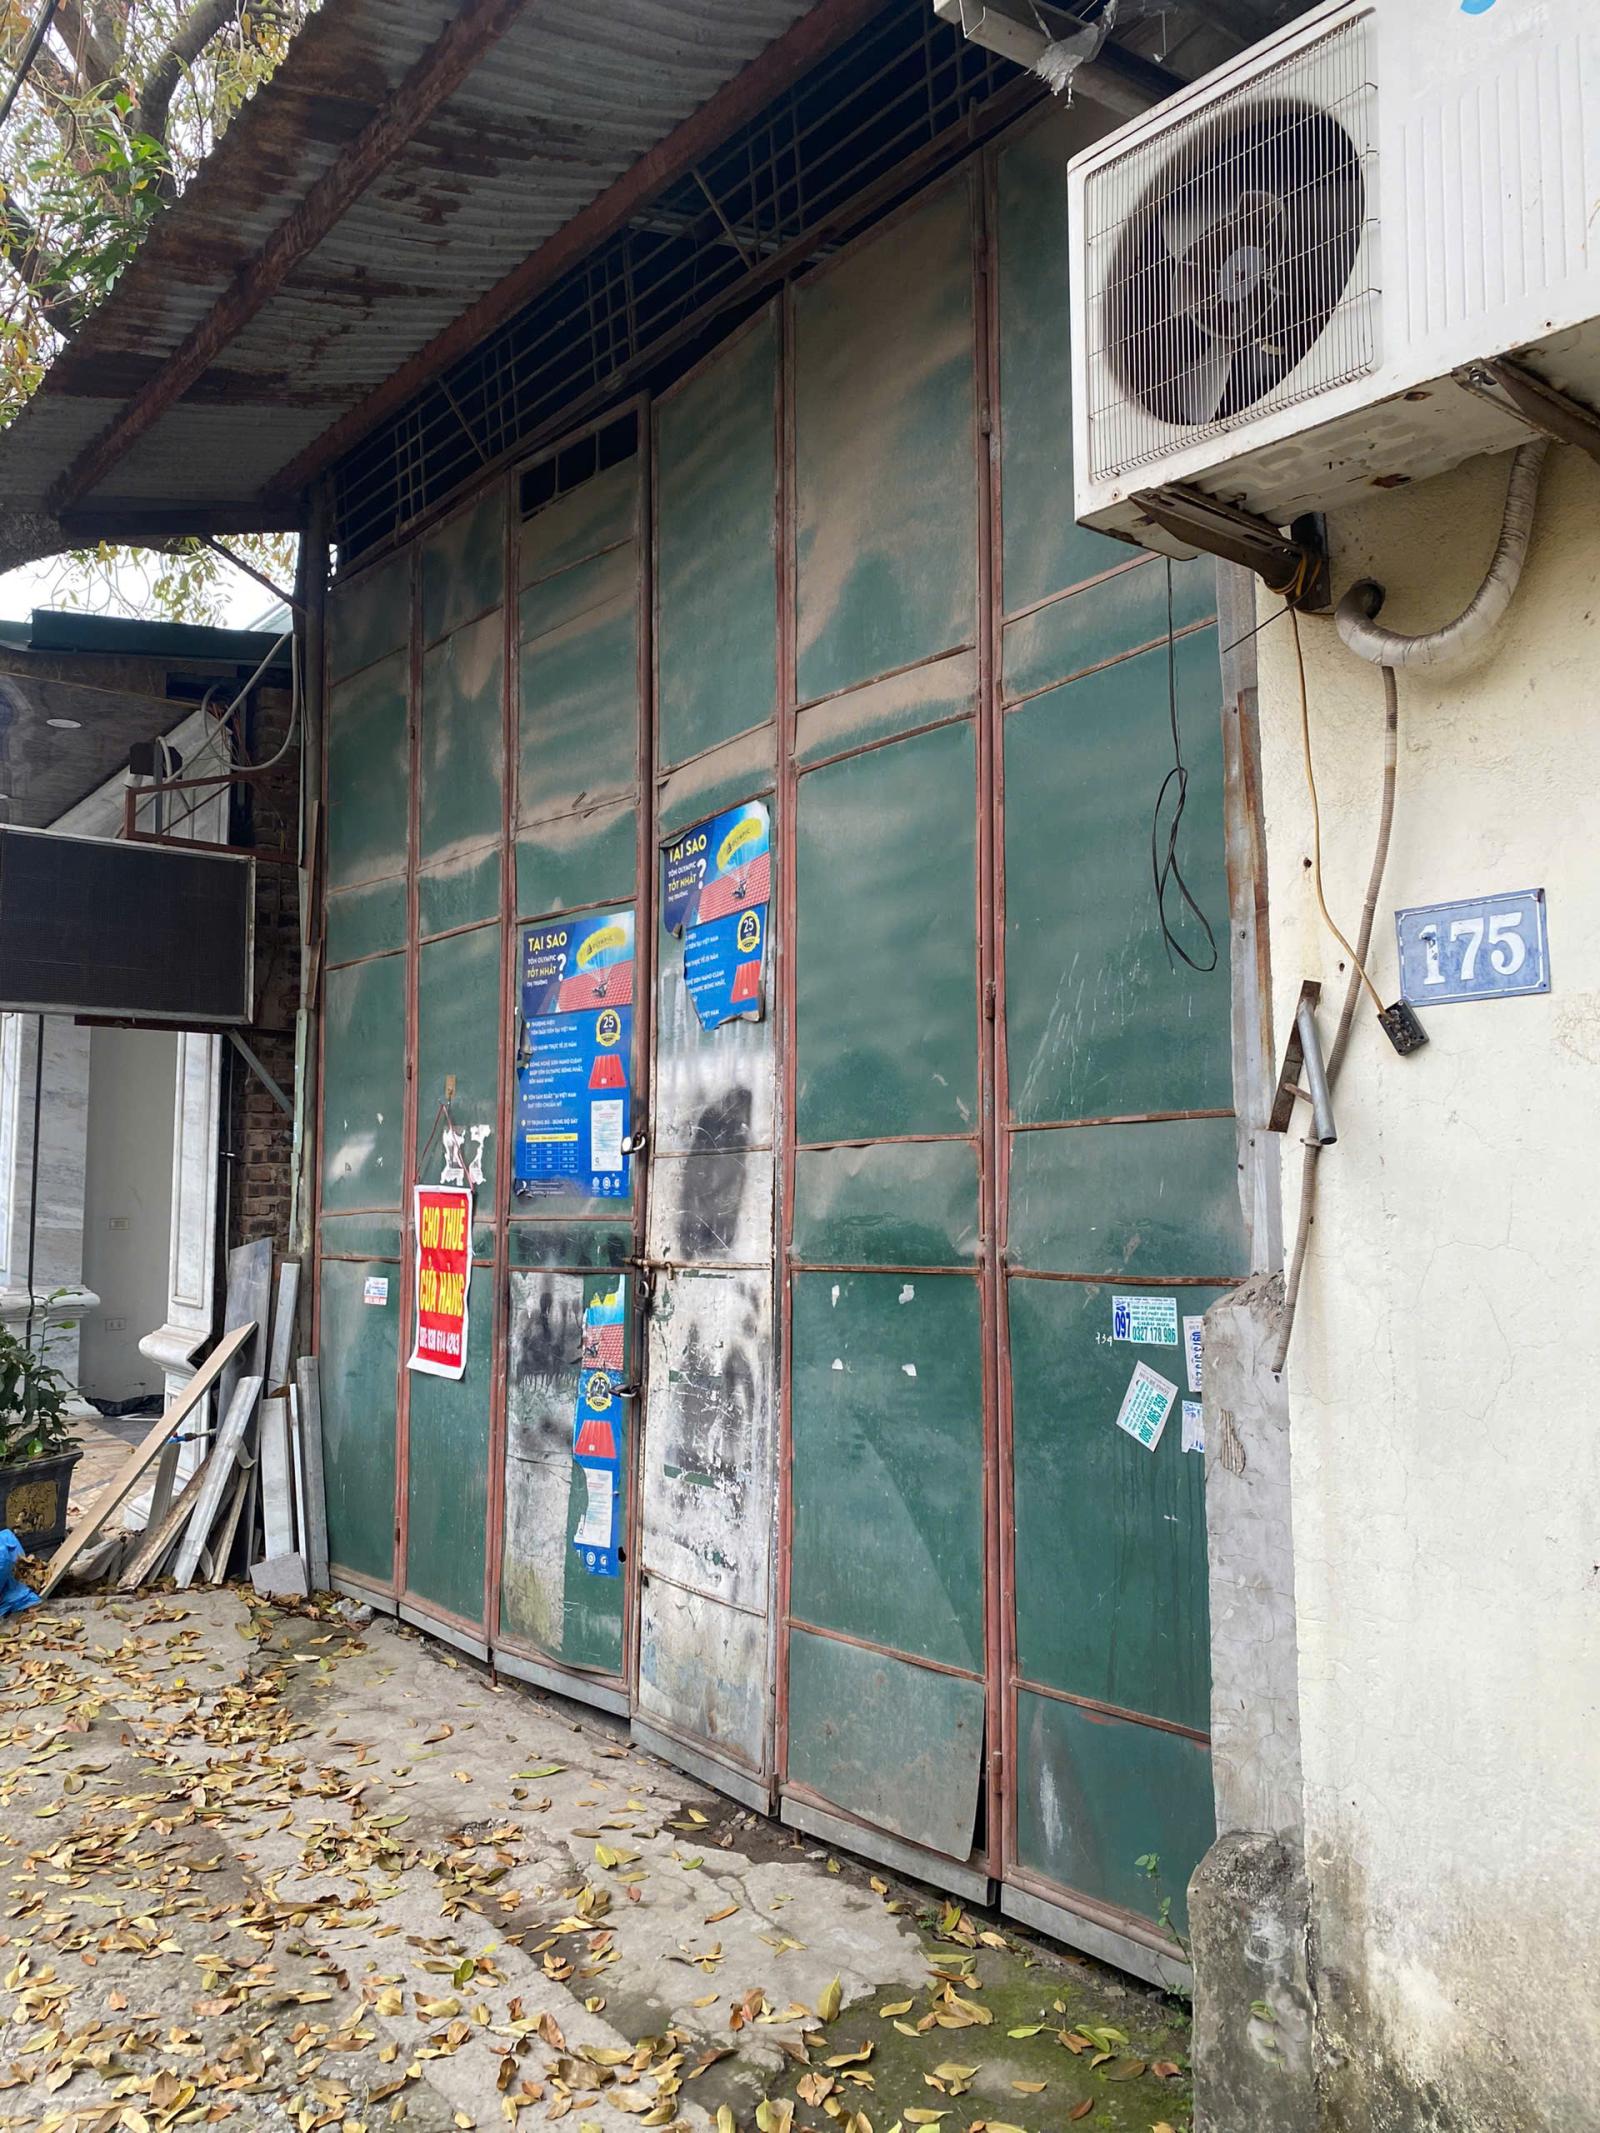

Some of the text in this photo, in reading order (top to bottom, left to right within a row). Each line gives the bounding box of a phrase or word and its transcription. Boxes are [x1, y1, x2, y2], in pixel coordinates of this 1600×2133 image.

[669, 834, 706, 865] TẠI SAO
[678, 861, 696, 874] OLYMPIC
[668, 871, 696, 892] TỐT NHẤT
[744, 918, 754, 932] 25
[528, 932, 567, 954] TẠI SAO
[1418, 911, 1526, 985] 175
[538, 954, 556, 963] OLYMPIC
[527, 964, 556, 978] TỐT NHẤT
[603, 1016, 614, 1028] 25
[422, 1199, 465, 1250] CHO THUÊ
[420, 1256, 464, 1317] CỬA HÀNG
